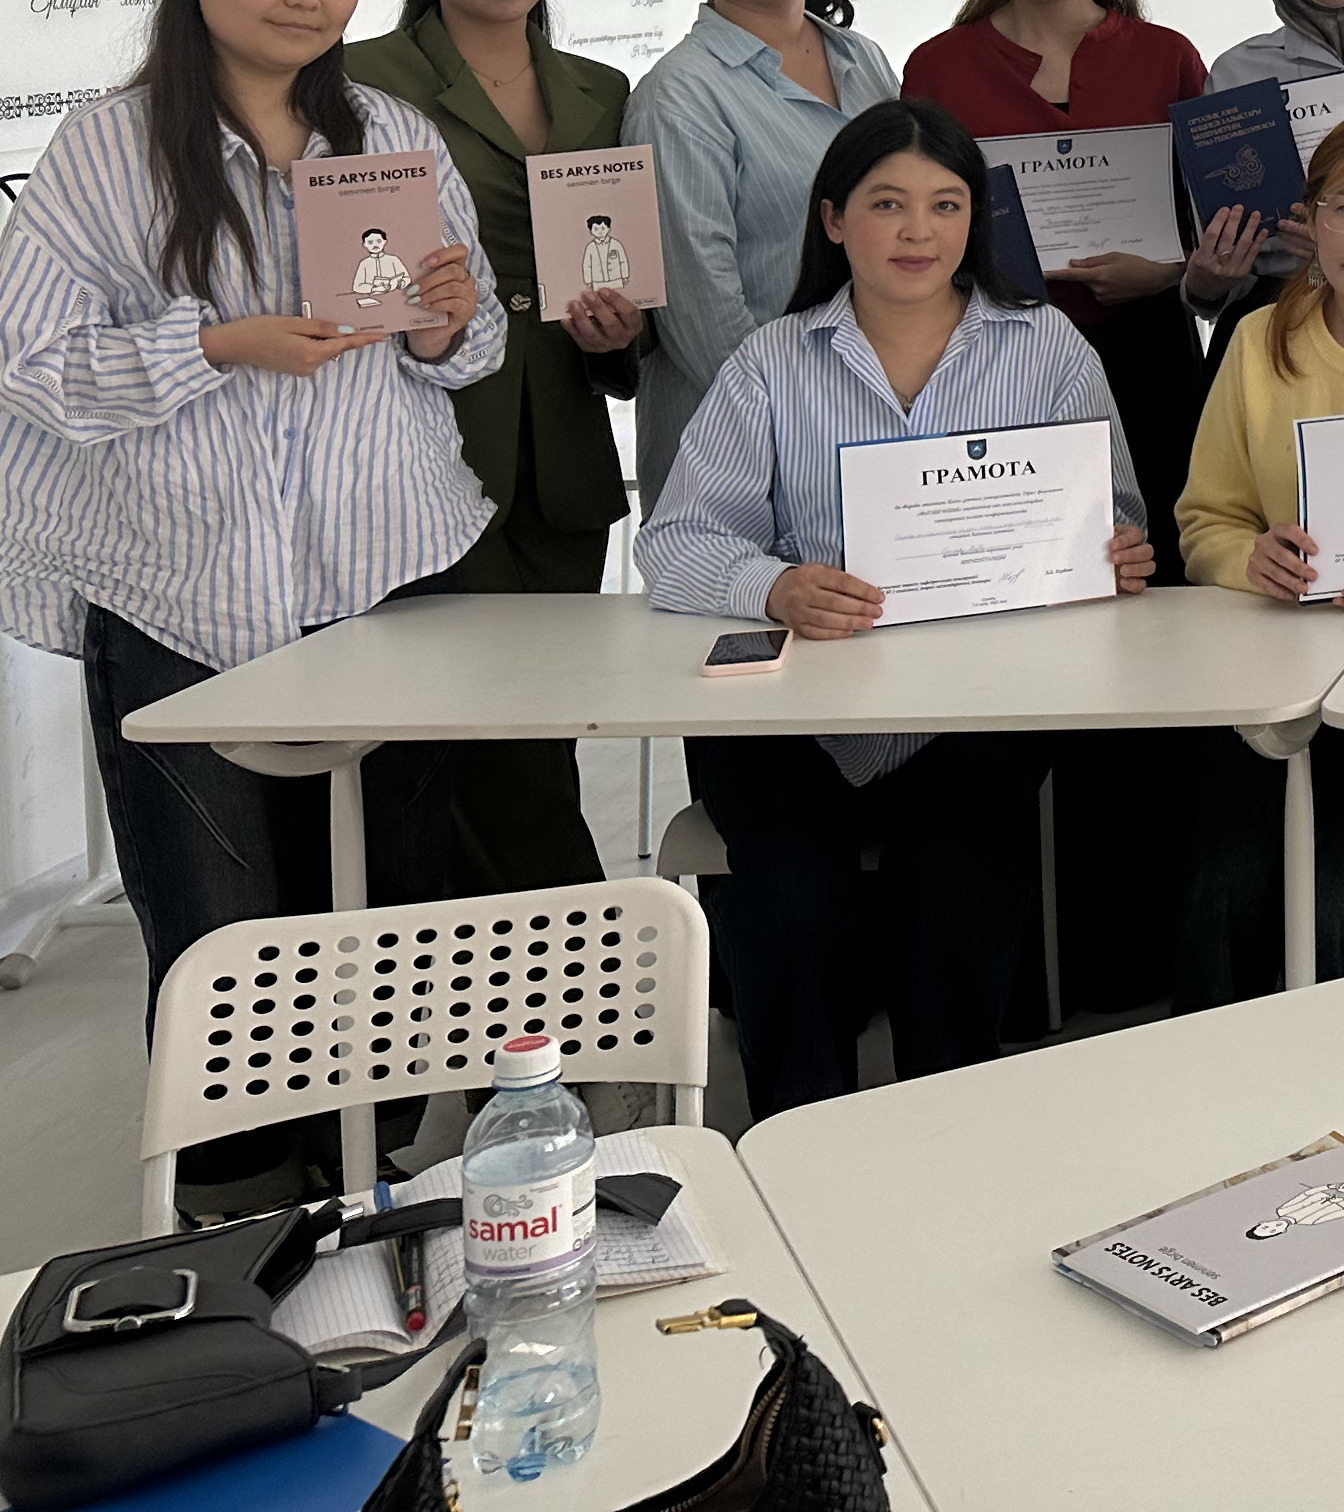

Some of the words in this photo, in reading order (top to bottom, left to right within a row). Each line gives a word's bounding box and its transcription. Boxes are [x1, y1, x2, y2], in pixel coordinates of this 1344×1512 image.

[541, 169, 563, 180] BES
[566, 165, 601, 178] ARYS
[603, 160, 644, 174] NOTES
[1021, 155, 1110, 174] ГРАМОТА
[309, 174, 335, 187] BES
[338, 171, 377, 185] ARYS
[381, 166, 427, 181] NOTES
[921, 460, 1037, 486] ГРАМОТА
[469, 1205, 558, 1242] samal
[483, 1245, 537, 1261] water
[1104, 1243, 1158, 1272] NOTES
[1150, 1265, 1206, 1296] ARYS
[1190, 1287, 1228, 1307] BES
